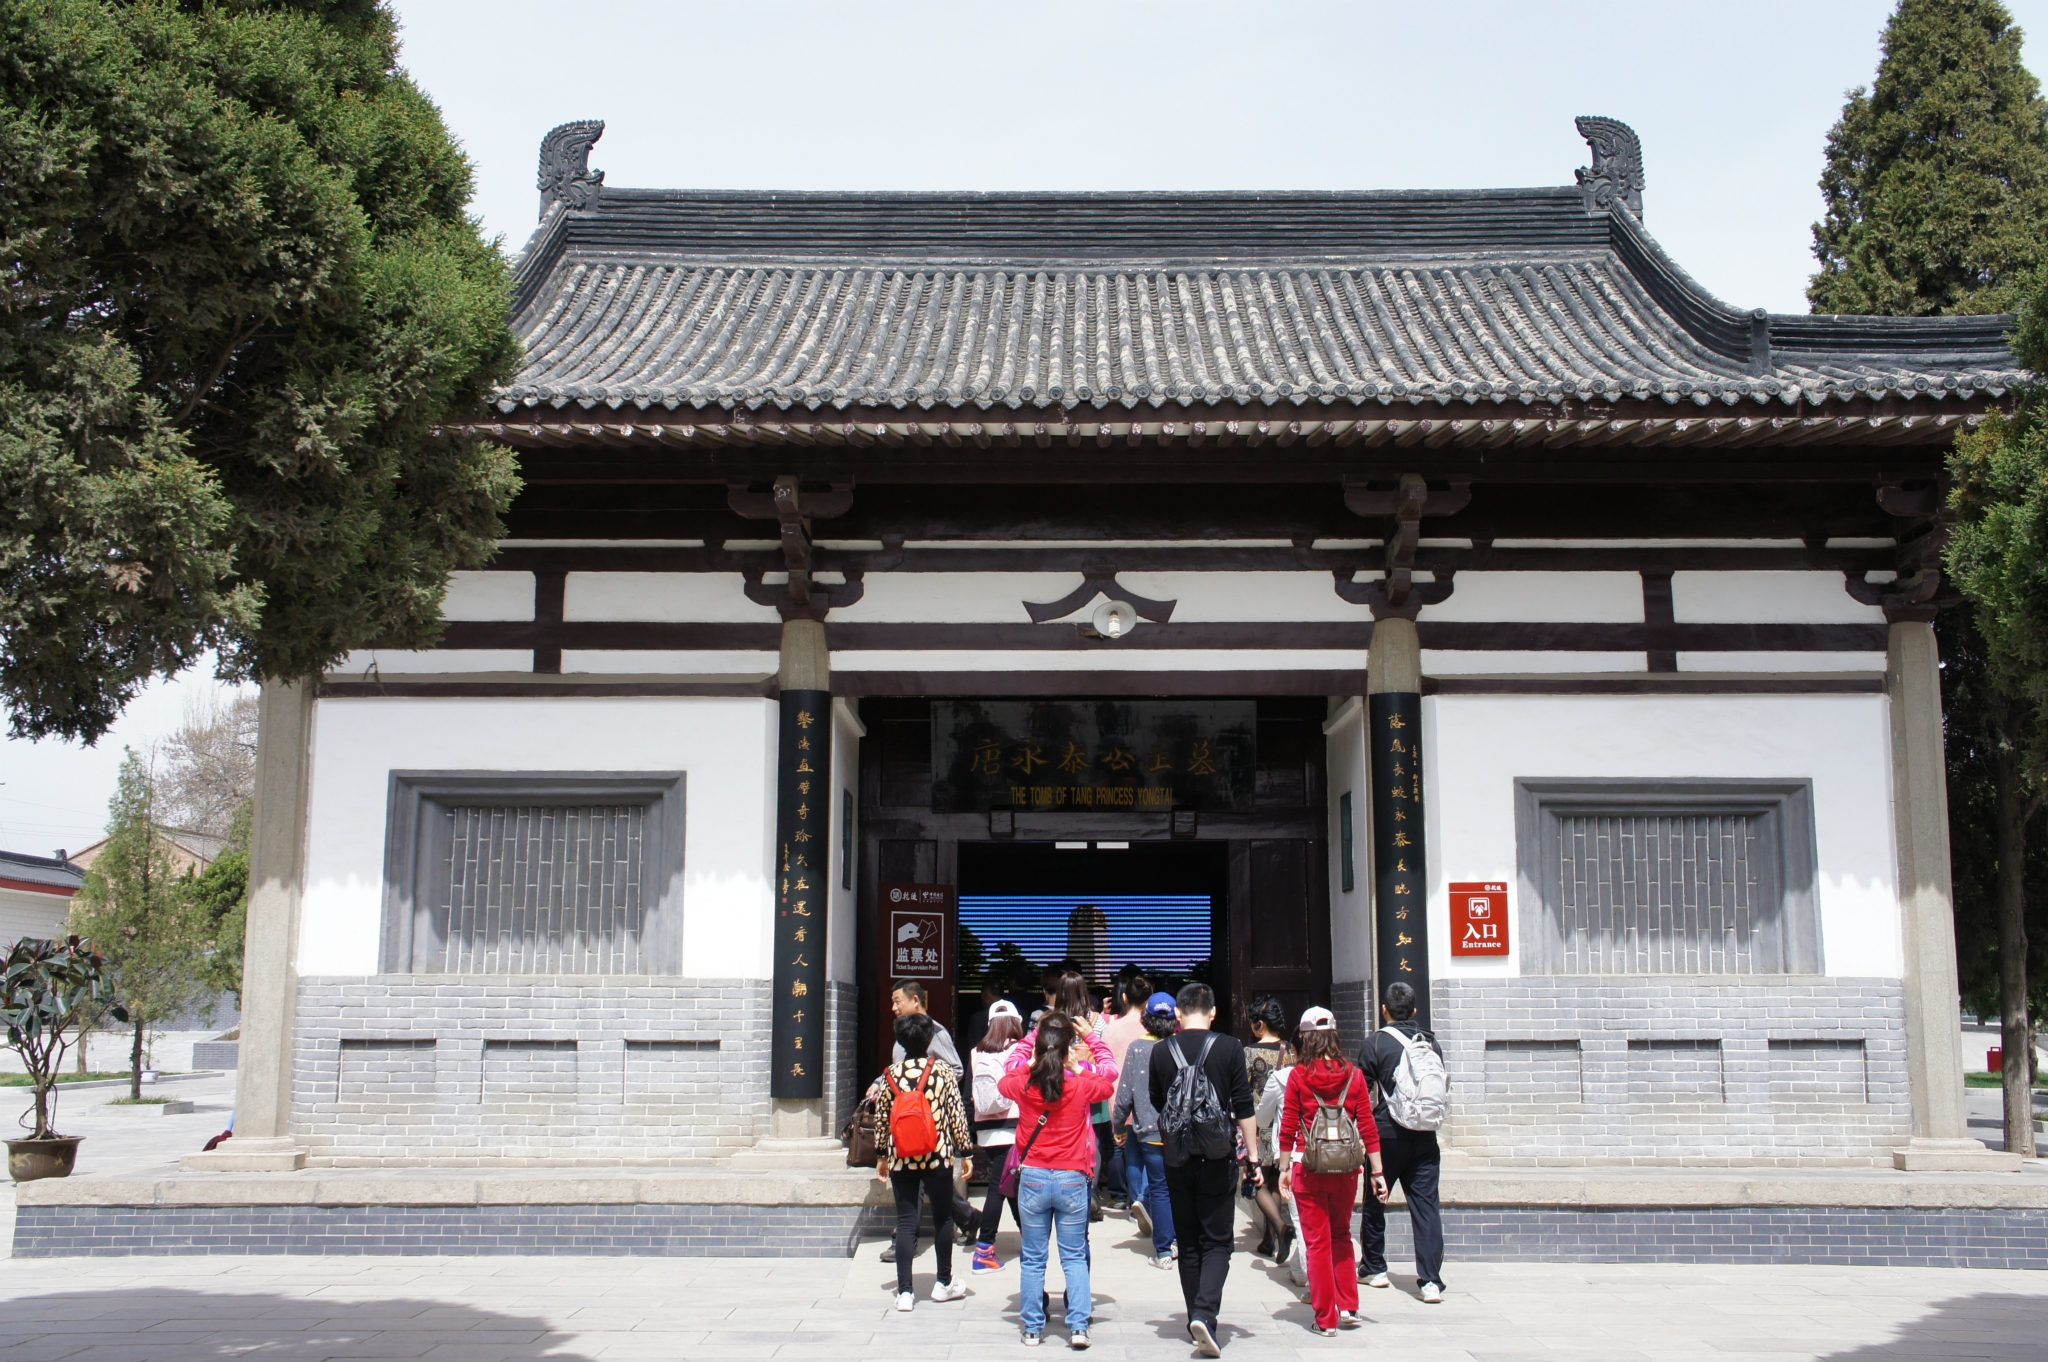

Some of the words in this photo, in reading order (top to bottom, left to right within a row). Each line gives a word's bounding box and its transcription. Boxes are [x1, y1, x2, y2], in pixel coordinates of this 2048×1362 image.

[971, 739, 1217, 776] 唐永泰公主墓
[1010, 786, 1026, 805] THE
[1030, 786, 1052, 805] TOMB
[1056, 786, 1067, 805] OF
[1071, 786, 1092, 805] TANG
[1096, 786, 1134, 805] PRINCESS
[1138, 786, 1173, 805] YONGTAI
[1463, 923, 1497, 940] 入口
[1462, 941, 1502, 949] Entrance
[896, 947, 938, 963] 监票处
[907, 964, 928, 972] Supervision
